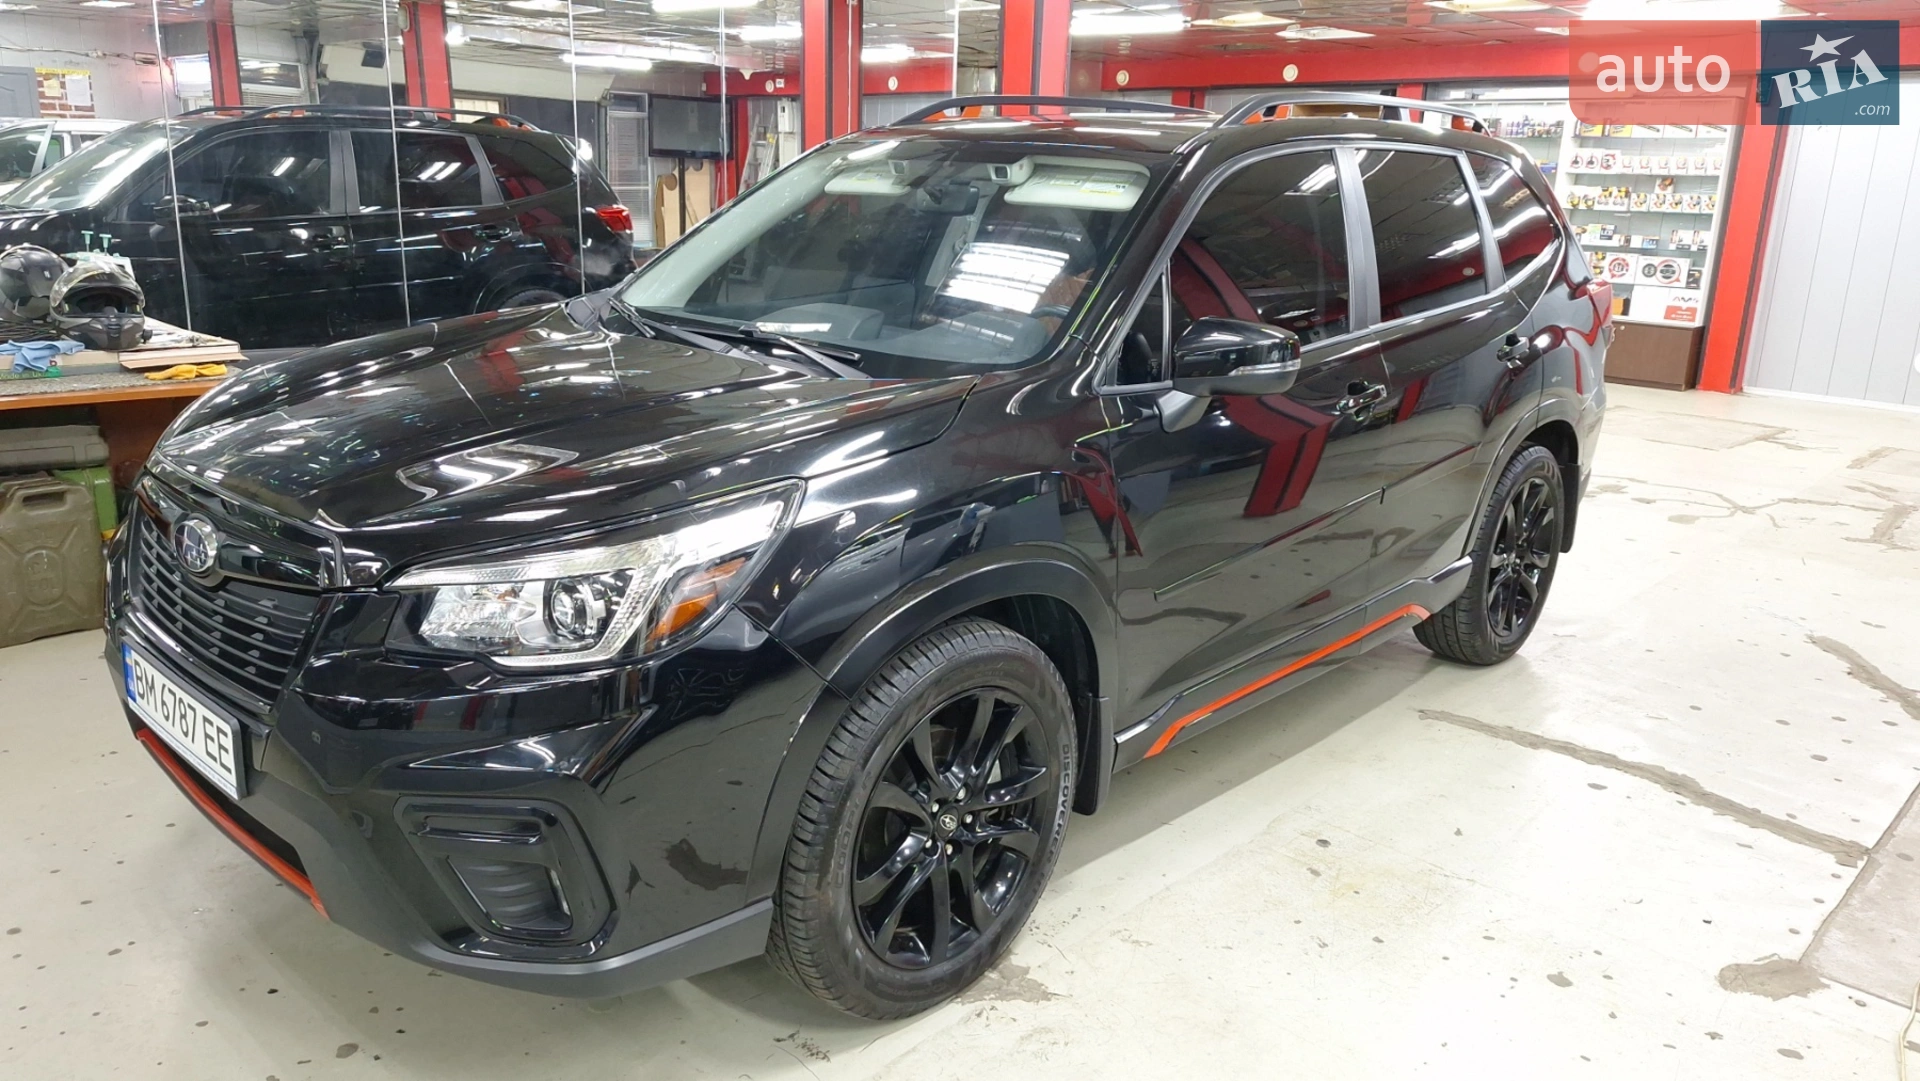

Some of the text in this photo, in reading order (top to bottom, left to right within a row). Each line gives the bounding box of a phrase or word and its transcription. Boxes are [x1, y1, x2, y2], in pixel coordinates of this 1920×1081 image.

[133, 659, 232, 775] BM 6787 EE
